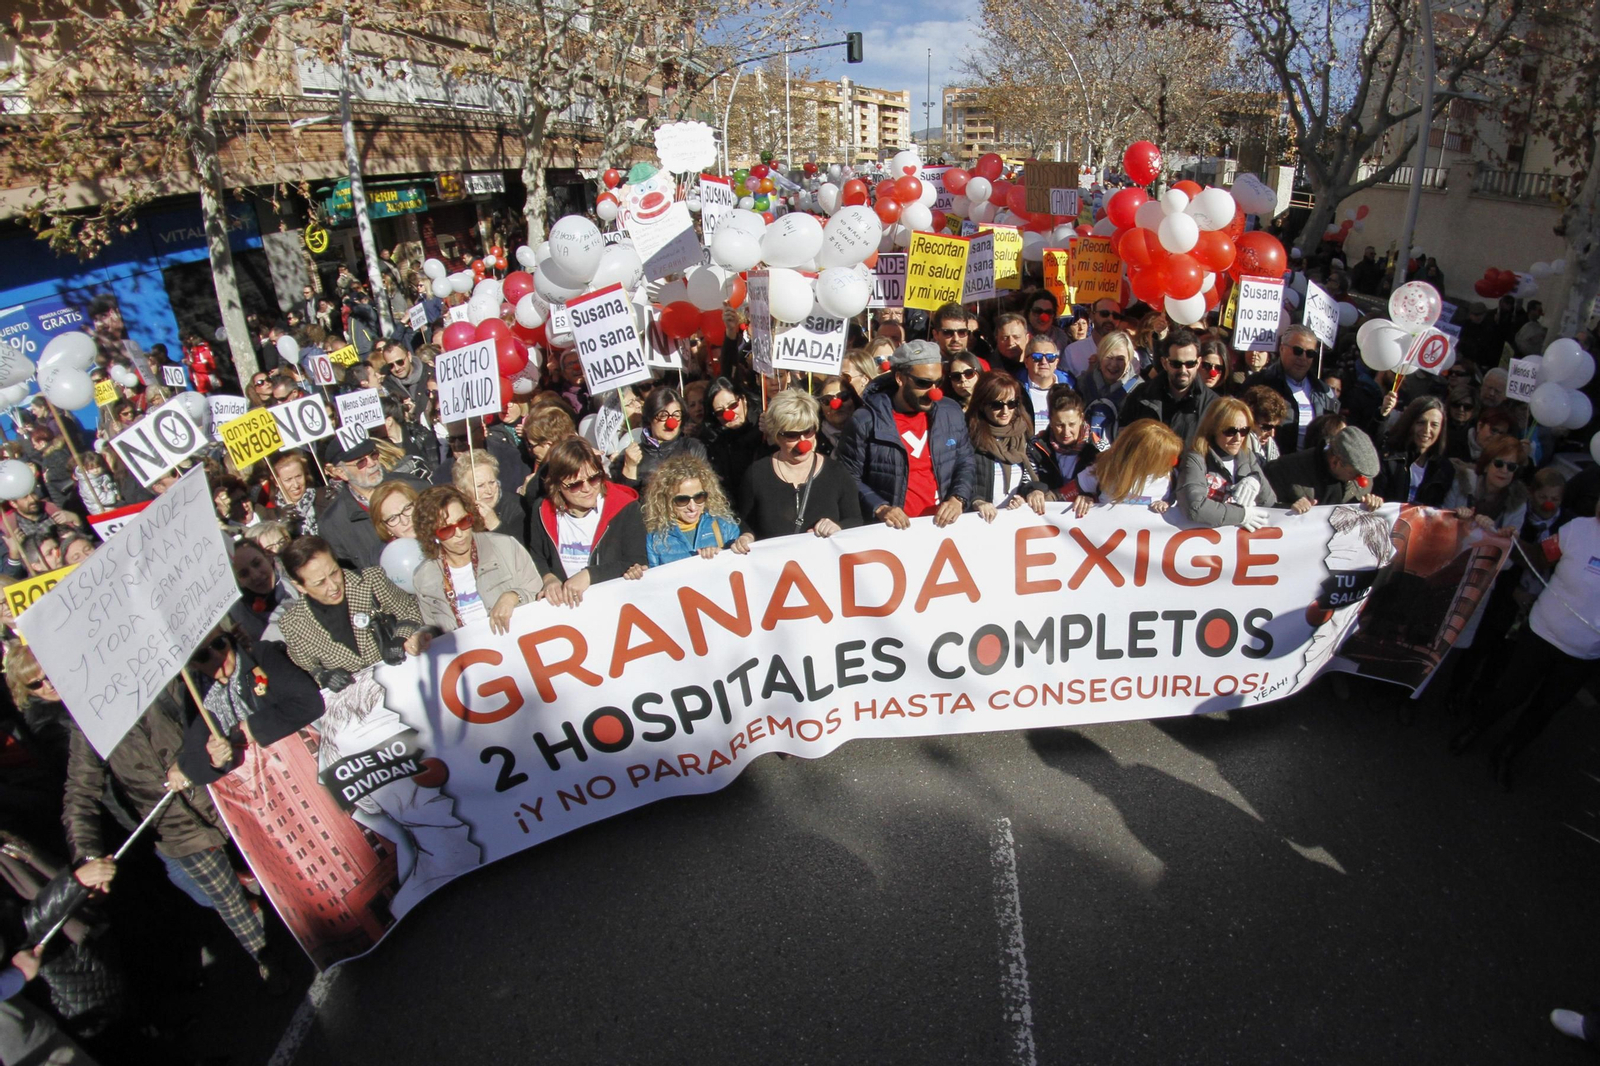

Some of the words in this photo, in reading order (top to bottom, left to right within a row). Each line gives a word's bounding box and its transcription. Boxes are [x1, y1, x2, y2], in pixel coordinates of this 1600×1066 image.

[920, 172, 944, 182] Susan
[911, 236, 966, 259] ¡Recortan
[994, 247, 1020, 261] salud
[909, 260, 927, 276] mi
[927, 263, 963, 281] salud
[1077, 258, 1091, 272] mi
[1093, 259, 1120, 274] salud
[907, 285, 916, 301] y
[917, 284, 932, 299] mi
[933, 285, 960, 303] vida!
[1085, 276, 1097, 289] mi
[1098, 277, 1119, 293] vida!
[1241, 283, 1281, 304] Susana,
[42, 310, 83, 331] GRATIS
[555, 315, 566, 328] ES
[571, 298, 629, 328] Susana,
[804, 315, 844, 334] sana
[1239, 307, 1254, 321] no
[1256, 308, 1279, 322] sana
[579, 337, 597, 355] no
[599, 325, 636, 349] sana
[1236, 326, 1278, 345] ¡NADA!
[775, 336, 841, 363] ¡NADA!
[165, 368, 184, 385] NO
[439, 346, 490, 384] DERECHO
[587, 347, 645, 387] ¡NADA!
[214, 400, 246, 415] Sanidad
[259, 411, 274, 427] TU
[442, 399, 451, 417] a
[271, 399, 327, 442] NO
[114, 408, 196, 482] NO
[228, 423, 282, 465] ROBAN
[339, 422, 367, 450] NO
[54, 546, 118, 633] JESUS
[1336, 574, 1358, 588] TU
[92, 613, 146, 666] TODA
[149, 535, 213, 610] GRANADA
[441, 537, 982, 725] GRANADA
[1015, 524, 1283, 596] EXIGE
[480, 745, 529, 793] 2
[532, 637, 905, 772] HOSPITALES
[928, 607, 1273, 680] COMPLETOS
[1253, 676, 1288, 702] YEAH!
[556, 774, 617, 812] NO
[625, 706, 842, 789] PARAREMOS
[853, 691, 976, 721] HASTA
[987, 671, 1269, 711] CONSEGUIRLOS!
[335, 754, 378, 781] QUE
[376, 740, 407, 763] NO
[341, 759, 418, 801] DIVIDAN
